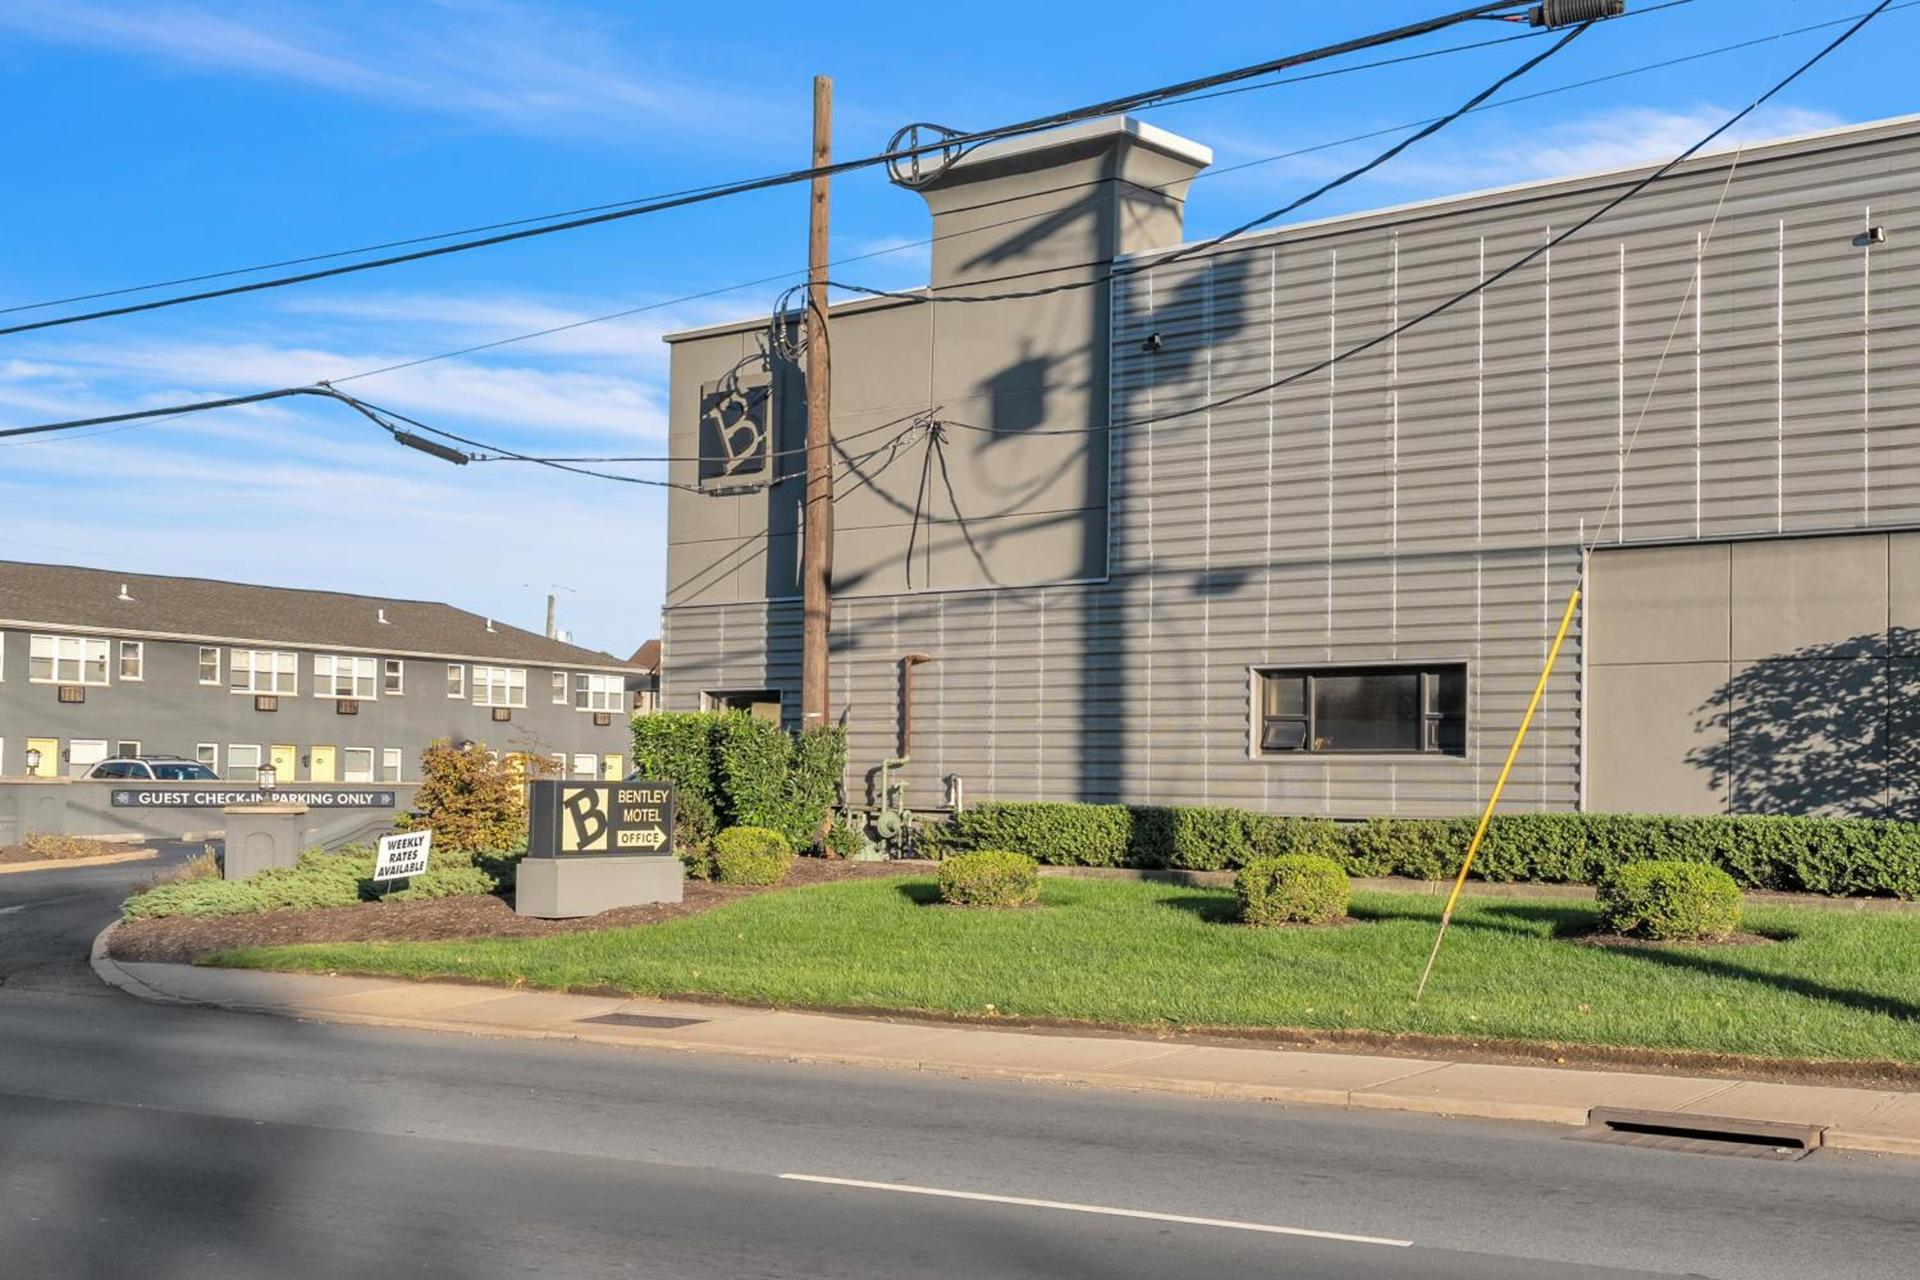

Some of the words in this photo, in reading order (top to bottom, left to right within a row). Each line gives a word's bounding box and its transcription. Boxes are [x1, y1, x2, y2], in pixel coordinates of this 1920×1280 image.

[138, 791, 190, 804] GUEST
[272, 793, 333, 805] PARKING
[338, 794, 373, 805] ONLY
[618, 790, 668, 803] BENTLEY
[563, 788, 608, 850] B
[623, 809, 662, 822] MOTEL
[387, 835, 425, 851] WEEKLY
[621, 833, 659, 844] OFFICE
[389, 849, 418, 864] RATES
[377, 860, 424, 878] AVAILABLE
